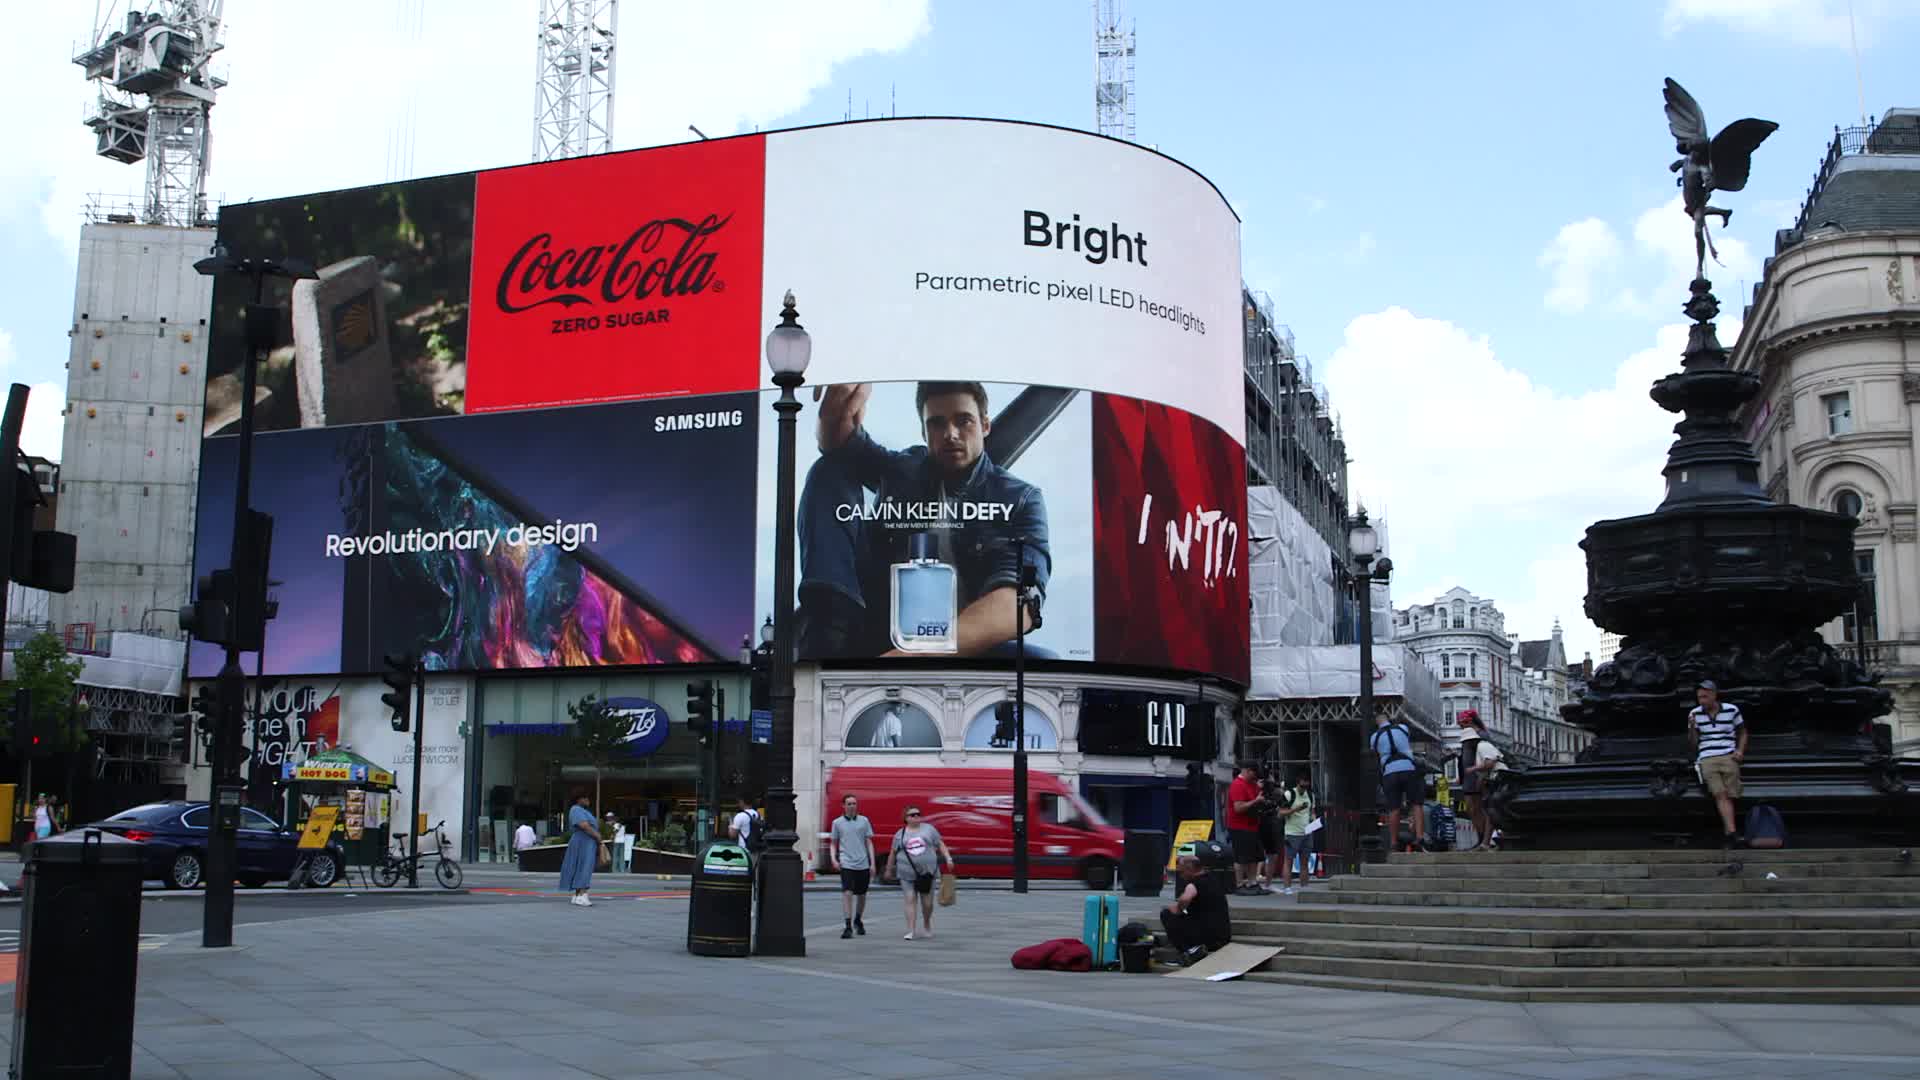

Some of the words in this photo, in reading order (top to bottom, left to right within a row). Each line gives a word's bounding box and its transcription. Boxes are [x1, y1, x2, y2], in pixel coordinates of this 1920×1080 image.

[1024, 210, 1147, 266] Bright
[496, 212, 734, 313] Coca-Cola
[915, 272, 1040, 295] Parametric
[1047, 280, 1092, 302] pixel
[1099, 287, 1134, 309] LED
[1139, 294, 1206, 335] headlights
[552, 316, 600, 334] ZERO
[606, 309, 669, 329] SUGAR
[655, 410, 742, 432] SAMSUNG
[836, 502, 902, 521] CALVIN
[907, 502, 957, 521] KLEIN
[963, 502, 1014, 521] DEFY
[325, 527, 500, 557] Revolutionary
[506, 519, 598, 551] design
[917, 625, 948, 637] DEFY
[1148, 701, 1185, 747] GAP
[301, 769, 321, 777] HOT
[325, 770, 347, 778] DOG
